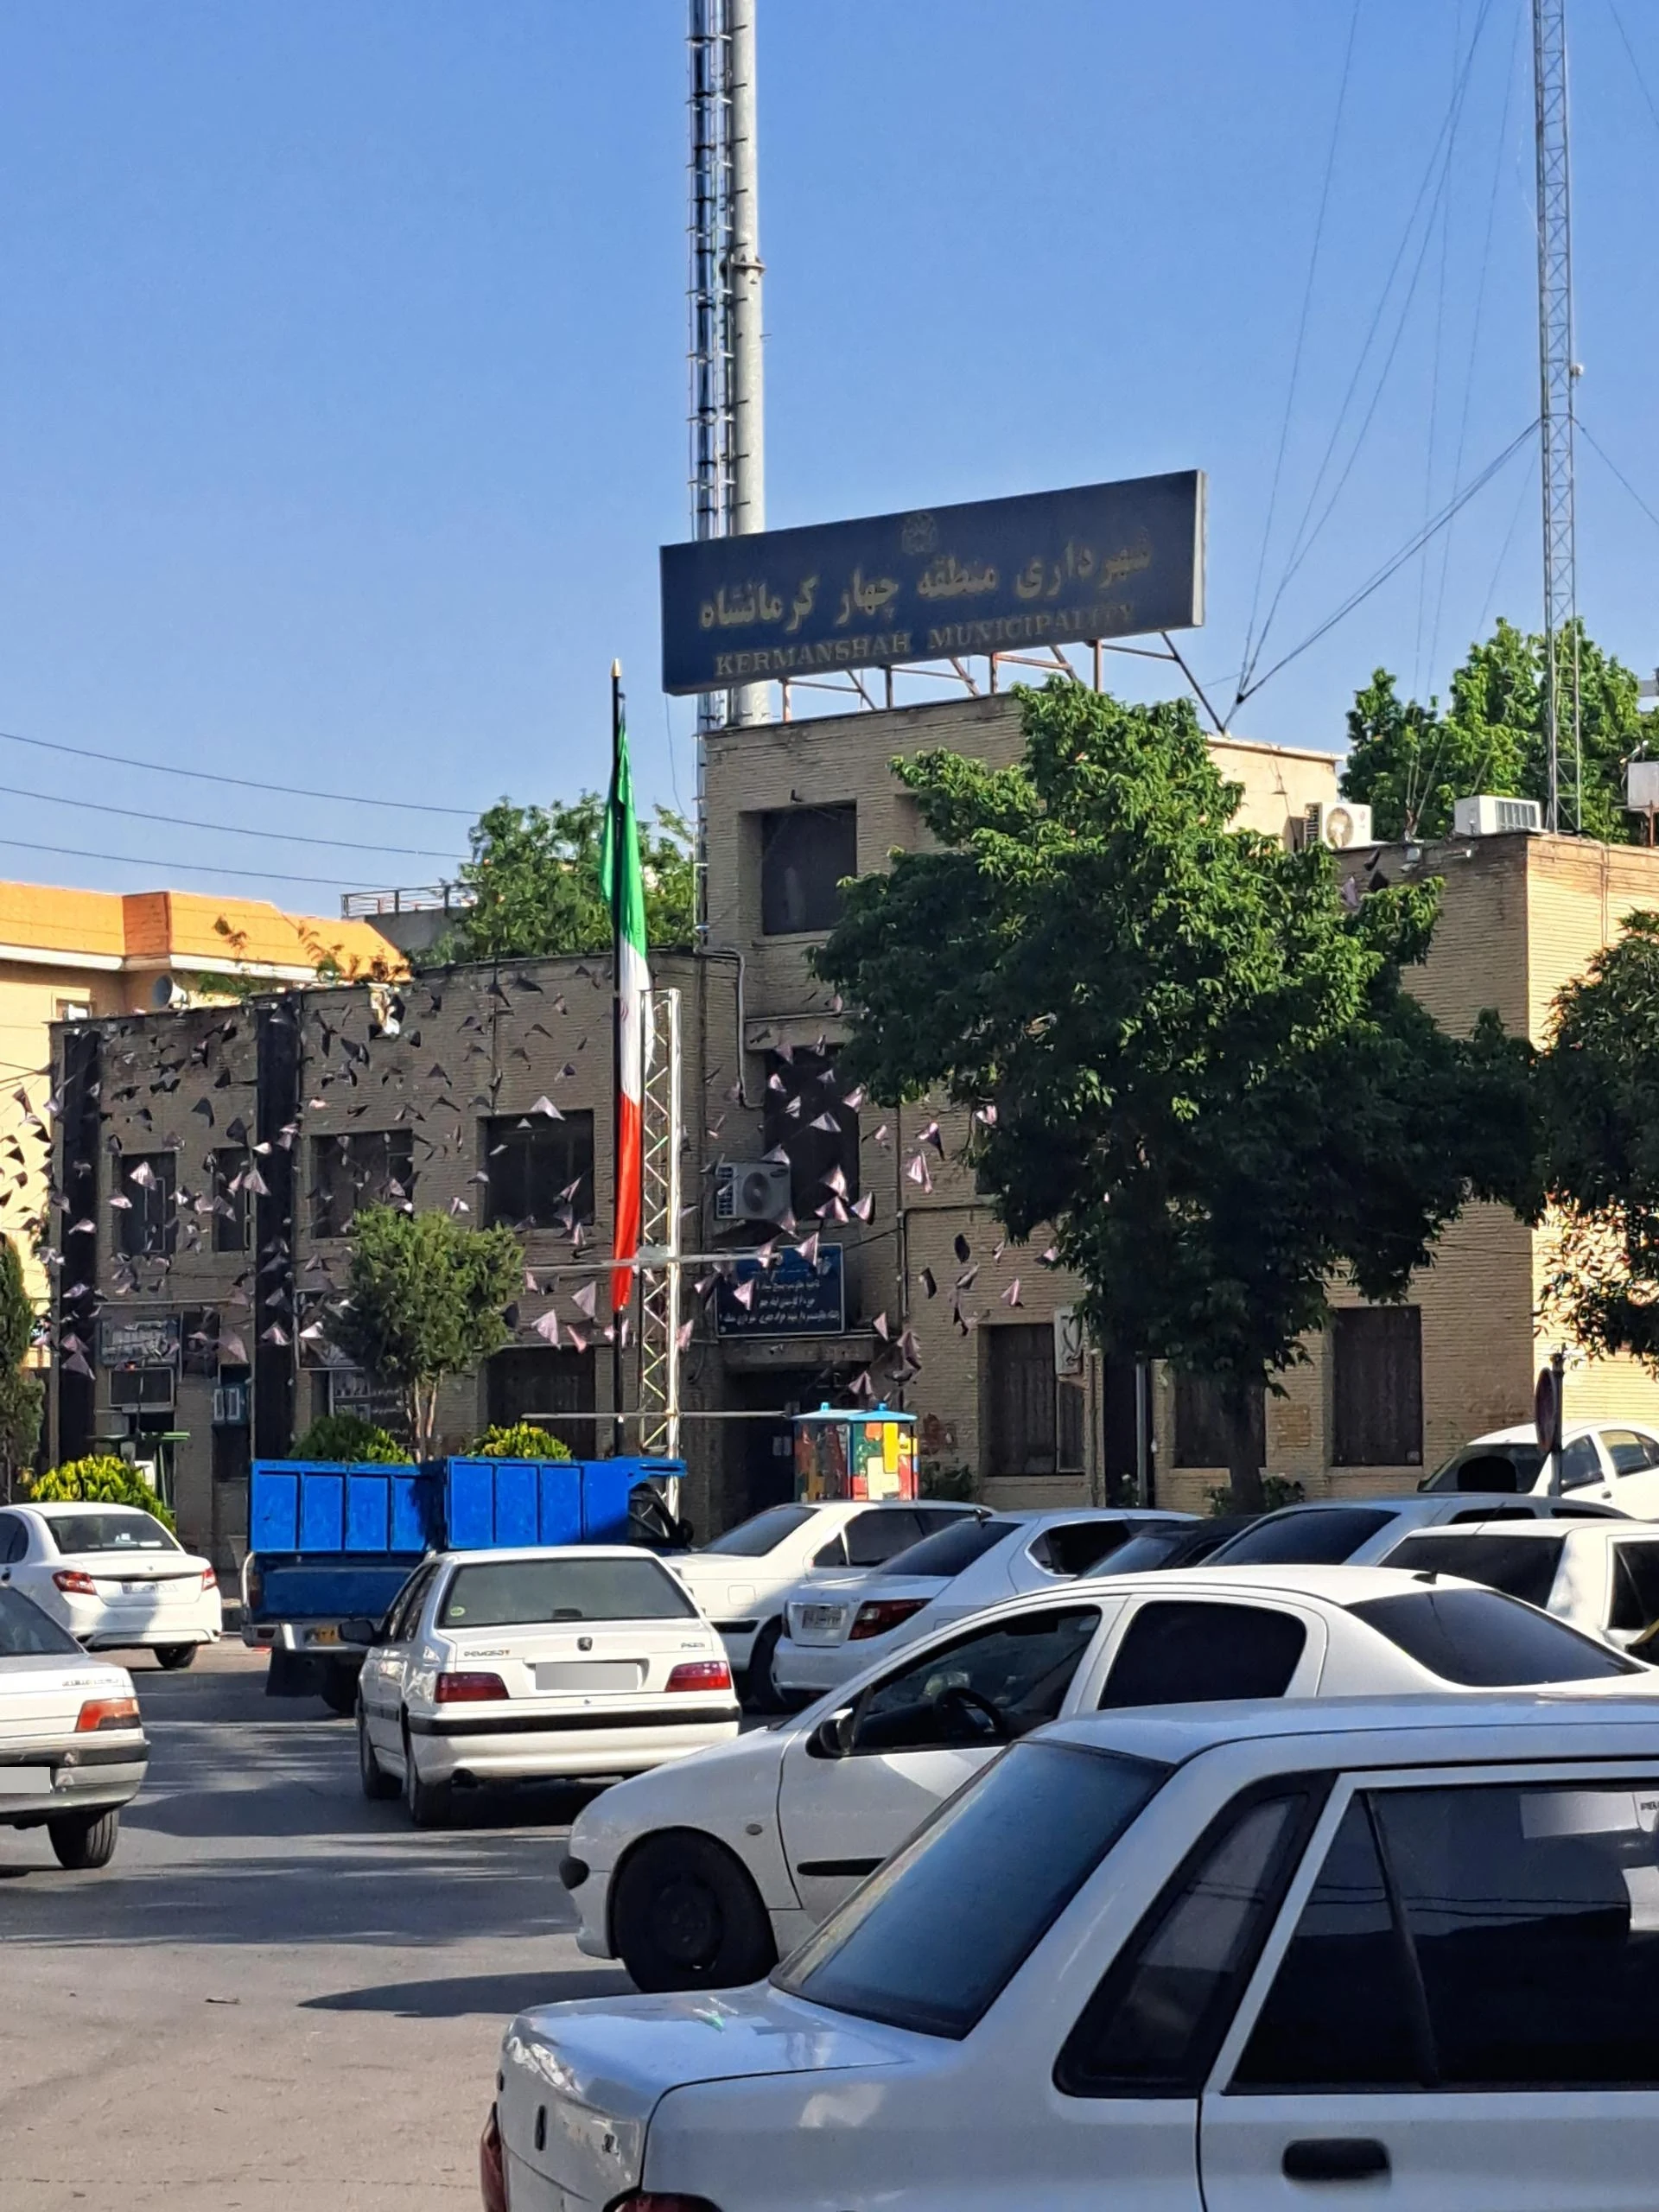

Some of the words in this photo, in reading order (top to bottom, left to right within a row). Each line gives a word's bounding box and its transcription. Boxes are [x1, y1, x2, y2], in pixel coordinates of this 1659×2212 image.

[916, 552, 999, 598] منطقه
[1015, 529, 1153, 599] شهرداری
[699, 574, 818, 632] کرمانشاه
[835, 566, 899, 627] چهار
[714, 632, 912, 677] KERMANSHAH
[927, 601, 1135, 651] MUNICIPALITY
